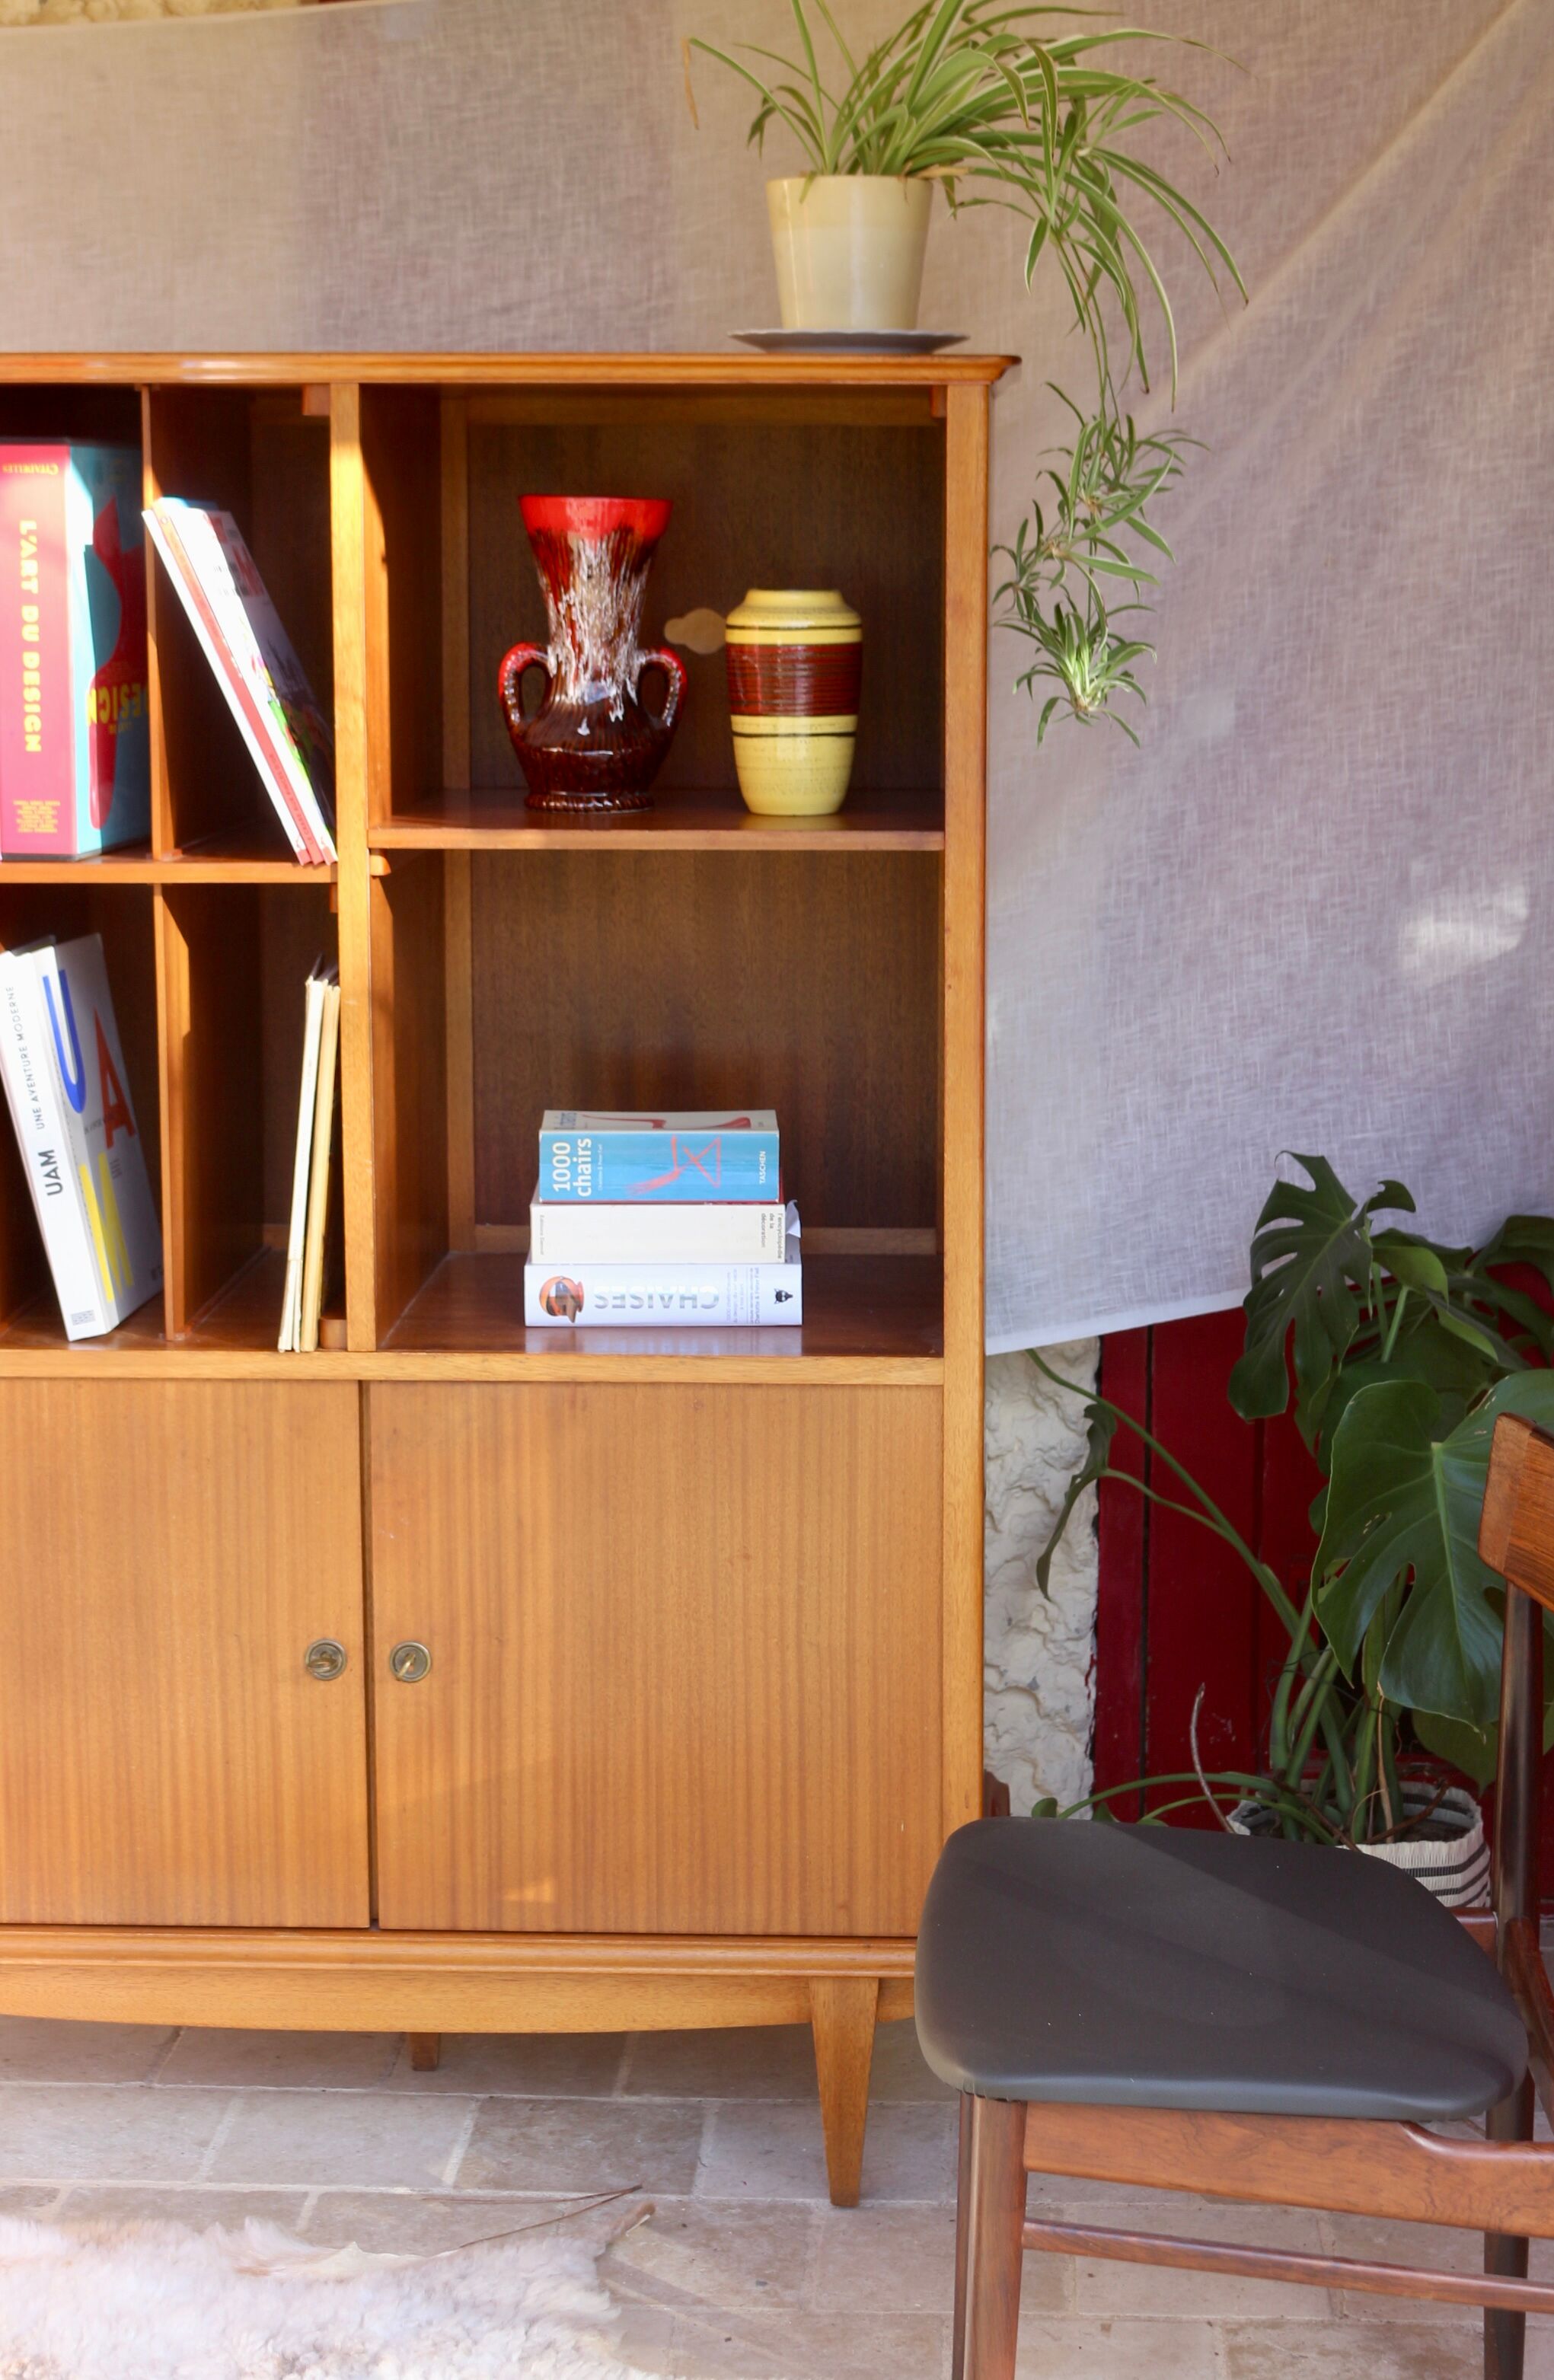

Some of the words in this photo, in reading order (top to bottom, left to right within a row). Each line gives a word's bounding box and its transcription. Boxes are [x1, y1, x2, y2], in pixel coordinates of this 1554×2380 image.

[19, 519, 37, 594] L'ART
[21, 605, 40, 643] DU
[22, 651, 42, 753] DESIGN
[86, 683, 149, 727] ESIGN
[6, 986, 24, 1041] MODERNE
[18, 1045, 40, 1102] AVENTURE
[94, 1006, 137, 1150] A
[33, 1108, 44, 1130] UNE
[38, 1149, 63, 1196] UAM
[551, 1142, 571, 1192] 1000
[573, 1137, 592, 1198] chairs
[593, 1284, 720, 1310] CHAISES
